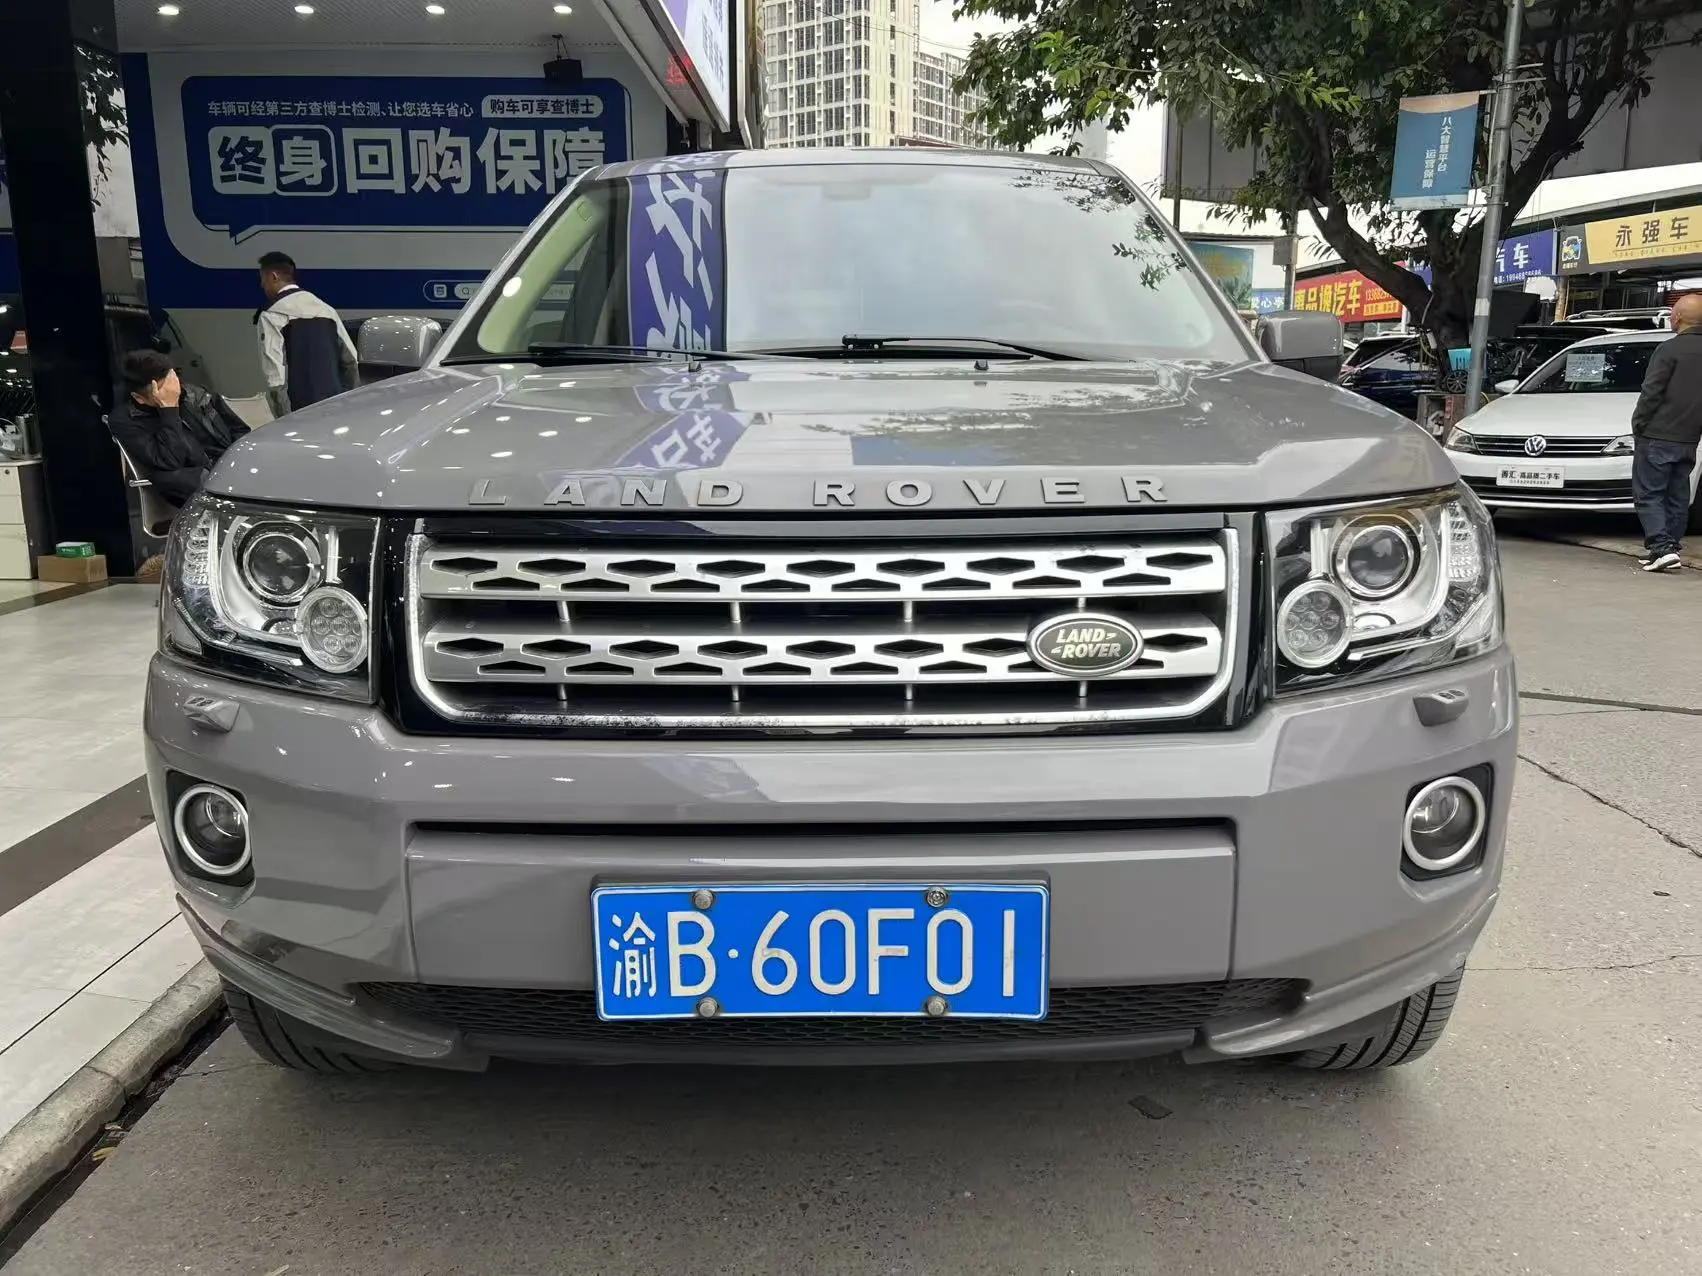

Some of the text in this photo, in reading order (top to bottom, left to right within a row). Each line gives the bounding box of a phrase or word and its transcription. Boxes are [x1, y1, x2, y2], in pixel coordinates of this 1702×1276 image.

[207, 101, 474, 118] 车辆可经第三方查博士检测、让您选车省心
[490, 99, 595, 115] 购车可享查博士
[216, 126, 606, 195] 终身回购保障
[1615, 216, 1690, 248] 永强车
[468, 475, 1169, 508] LAND ROVER
[1056, 628, 1105, 643] LAND
[1061, 643, 1121, 659] ROVER
[608, 908, 1015, 997] 渝B·60F01
